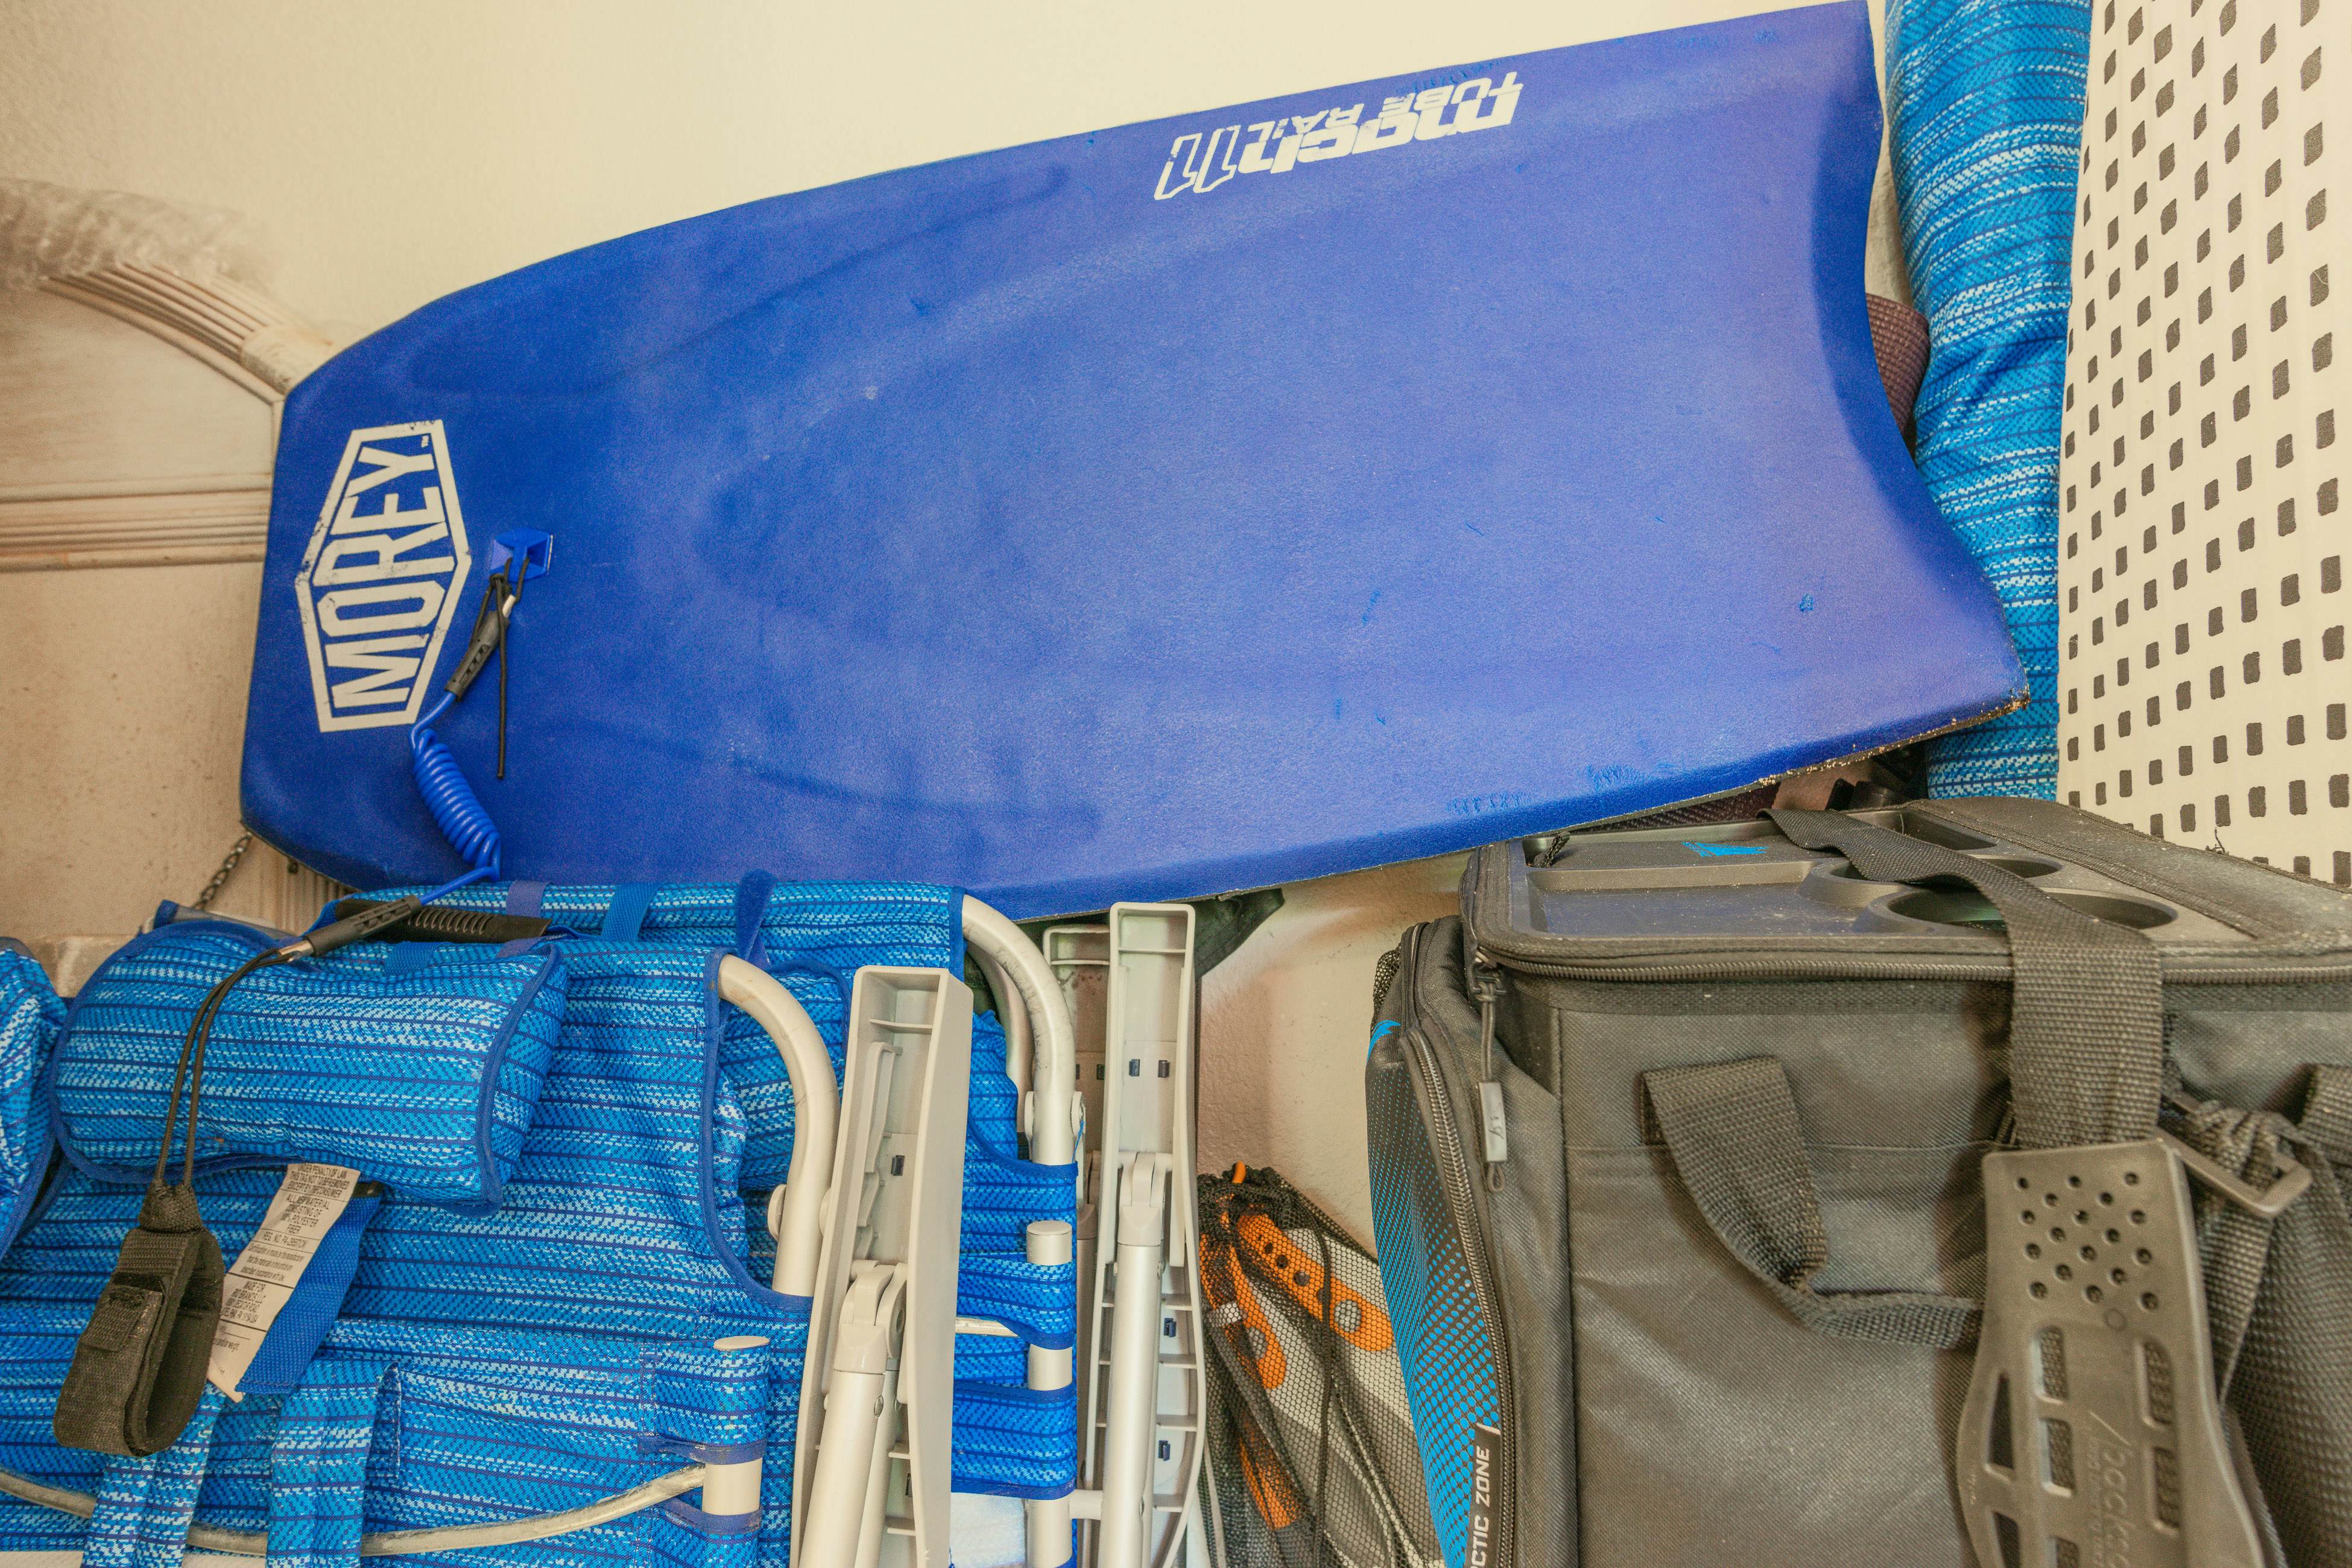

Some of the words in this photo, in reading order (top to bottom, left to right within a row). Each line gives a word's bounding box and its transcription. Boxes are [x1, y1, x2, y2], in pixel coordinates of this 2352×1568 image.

[1382, 72, 1523, 118] TUBE
[1247, 103, 1364, 142] RAIL
[312, 446, 455, 709] MOREY
[1475, 1446, 1490, 1507] ZONE
[1470, 1514, 1490, 1568] CTIC
